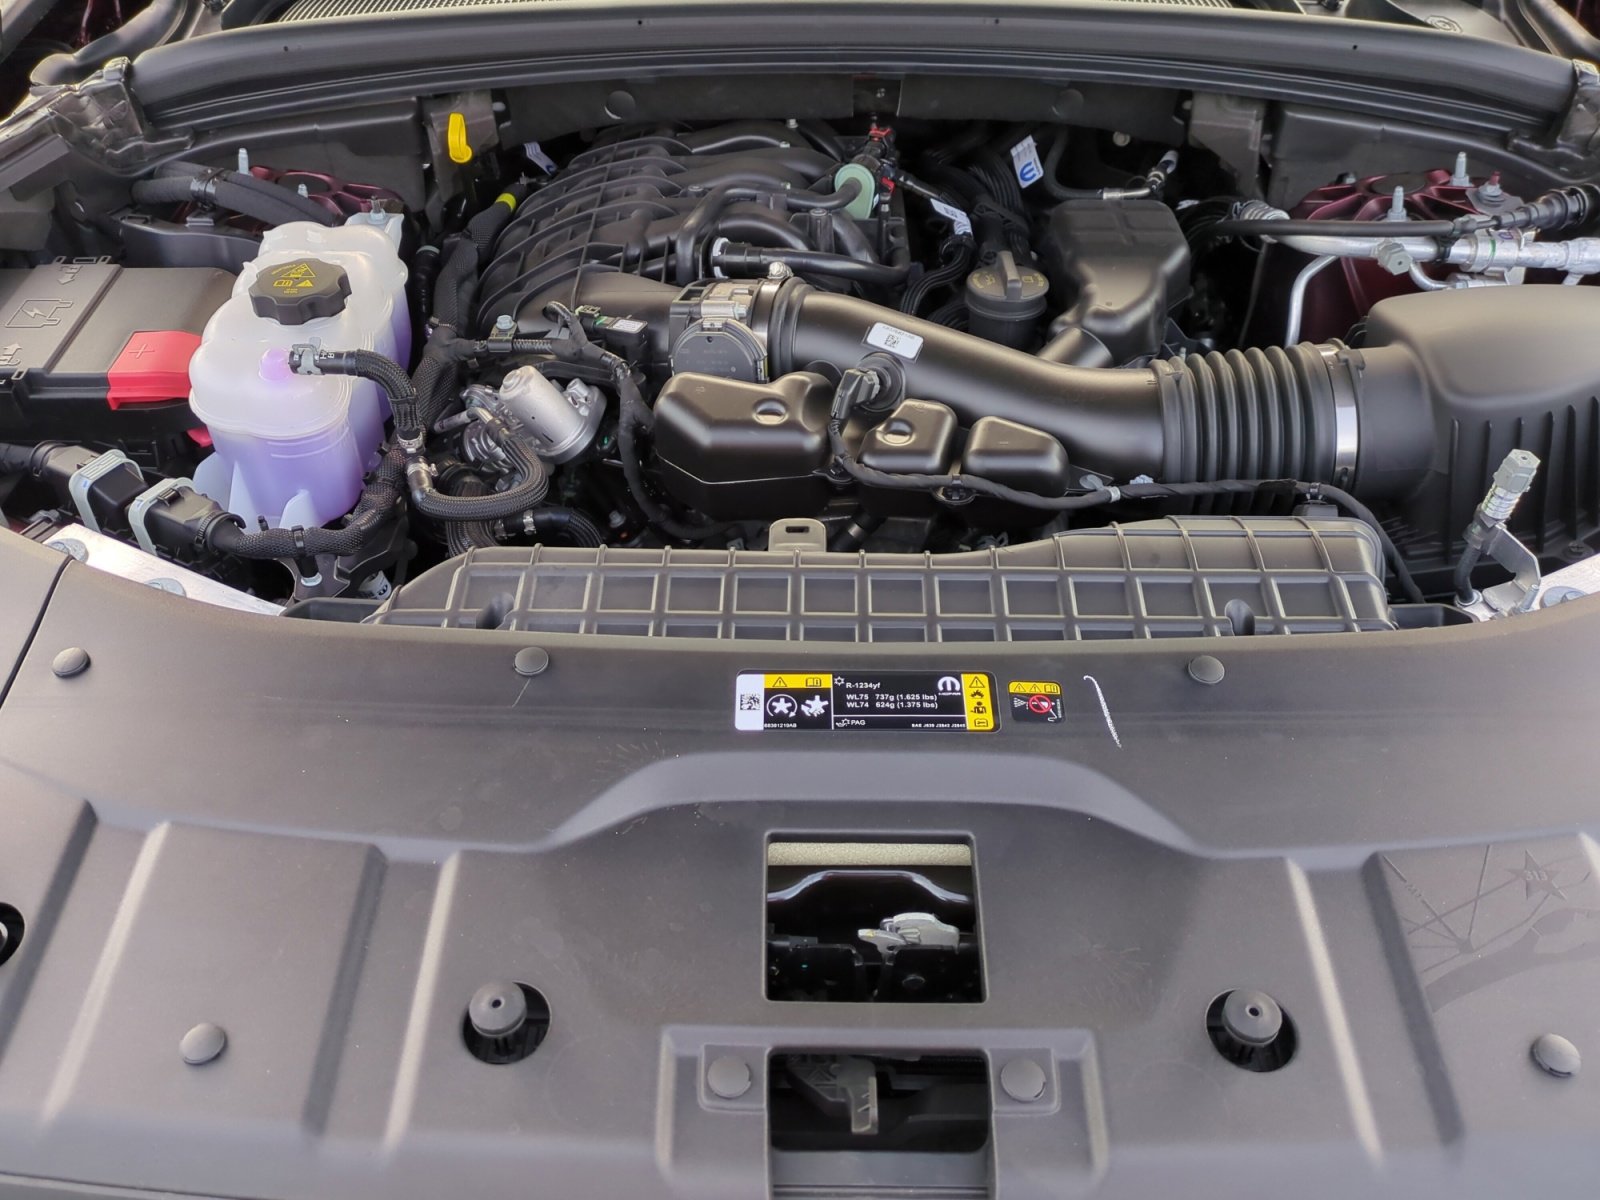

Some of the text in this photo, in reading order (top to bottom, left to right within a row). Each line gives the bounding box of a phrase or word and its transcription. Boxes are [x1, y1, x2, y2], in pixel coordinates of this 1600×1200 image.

[845, 682, 881, 690] R-1234yf
[875, 693, 895, 701] 737g
[896, 693, 920, 701] (1.625
[922, 693, 938, 701] lbs)
[875, 701, 895, 709] 624g
[896, 701, 921, 709] (1.375
[922, 701, 938, 709] lbs)
